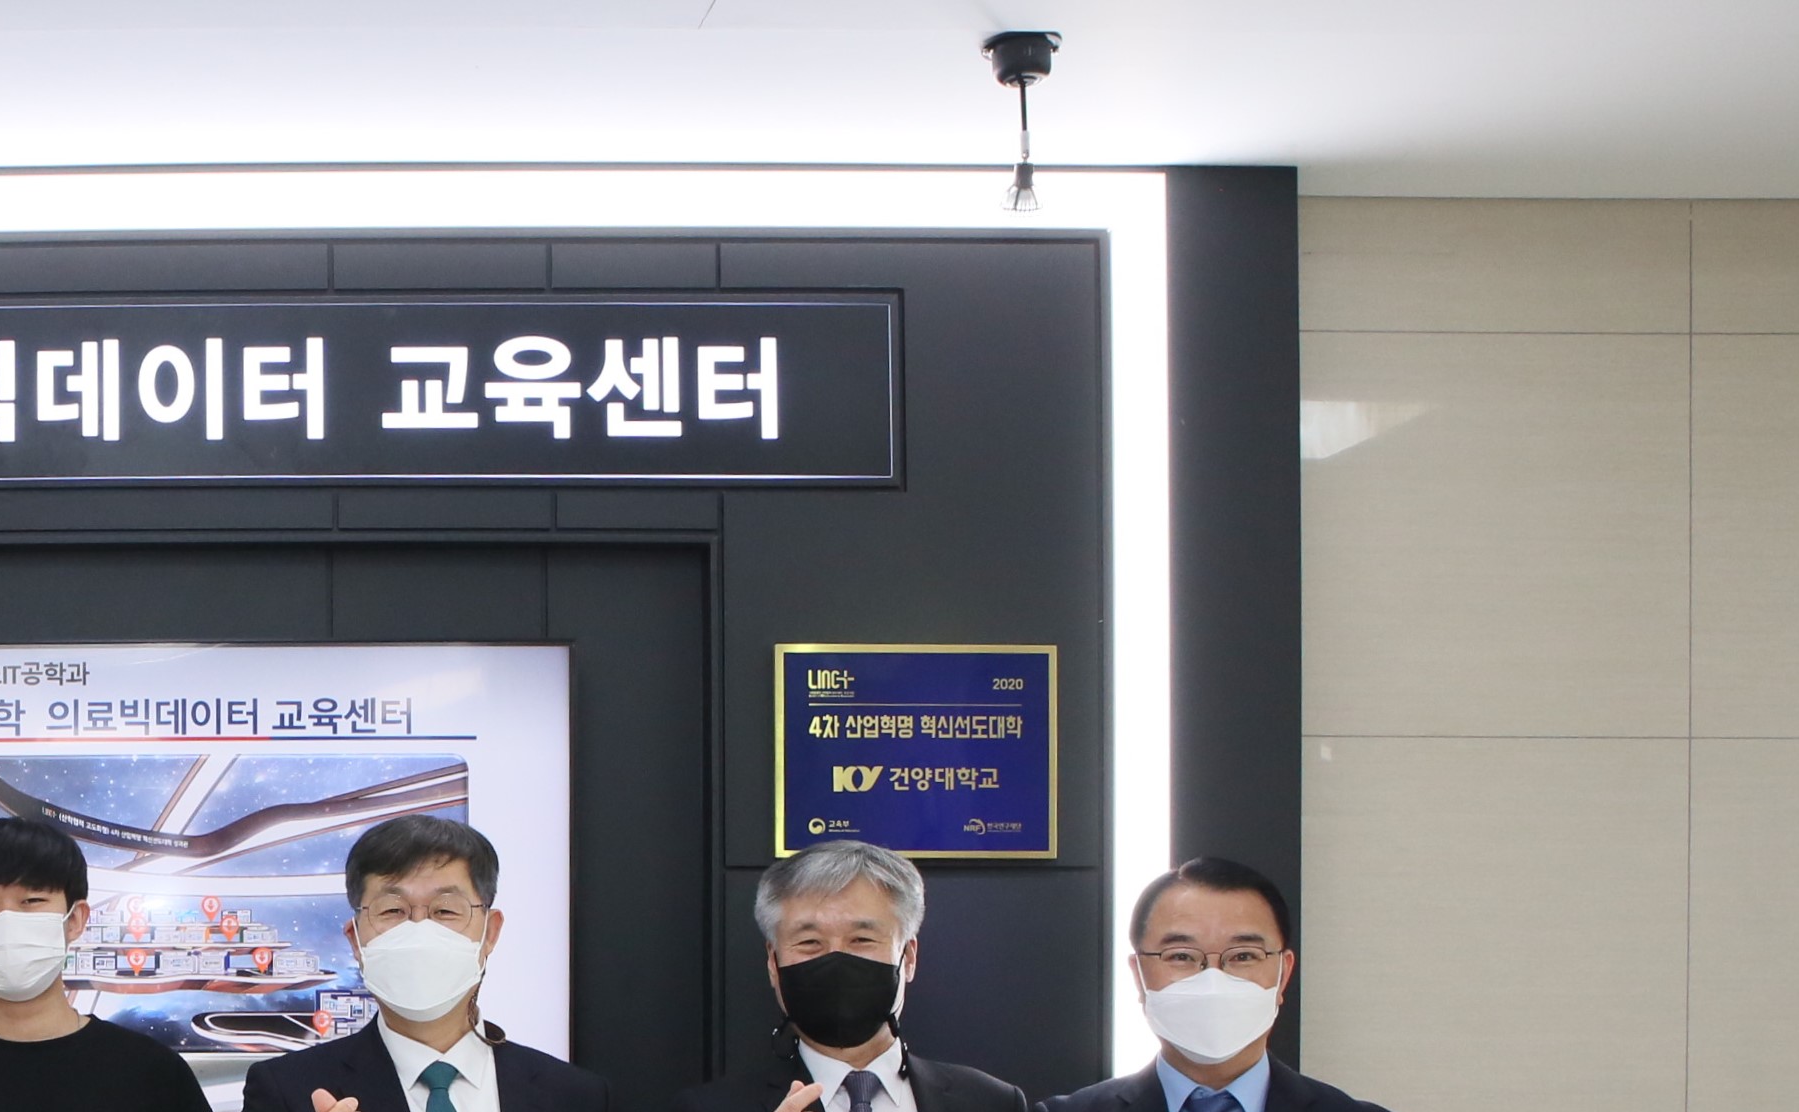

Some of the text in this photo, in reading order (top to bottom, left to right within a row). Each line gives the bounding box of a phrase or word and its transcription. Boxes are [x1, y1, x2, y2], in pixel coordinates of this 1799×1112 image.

[381, 334, 779, 440] 교육센터
[992, 678, 1024, 690] 2020
[45, 698, 260, 736] 의료빅데이터
[271, 697, 413, 735] 교육센터
[808, 714, 1023, 739] 4차 산업혁명 혁신선도대학
[888, 767, 1000, 791] 건양대학교
